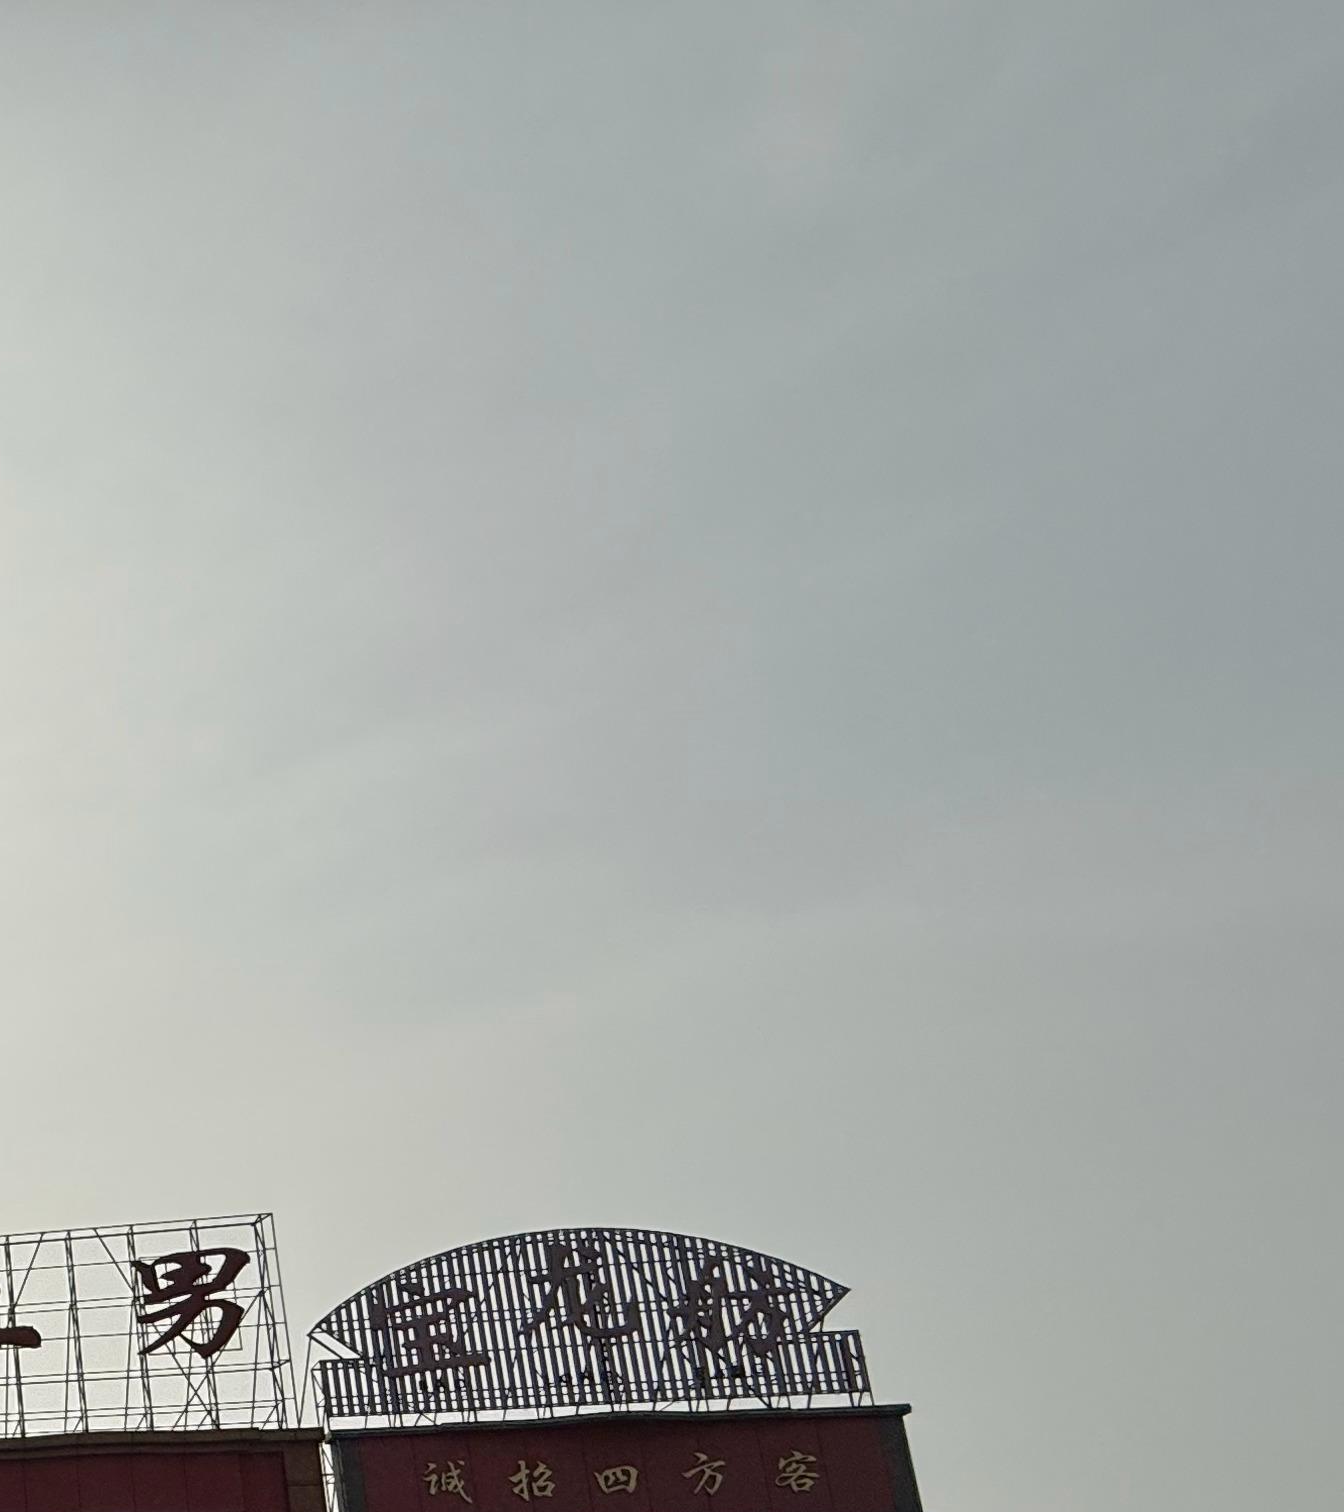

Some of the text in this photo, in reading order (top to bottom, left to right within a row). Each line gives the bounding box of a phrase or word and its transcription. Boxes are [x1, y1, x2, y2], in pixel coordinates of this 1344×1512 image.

[422, 1449, 821, 1503] 诚招四方客
